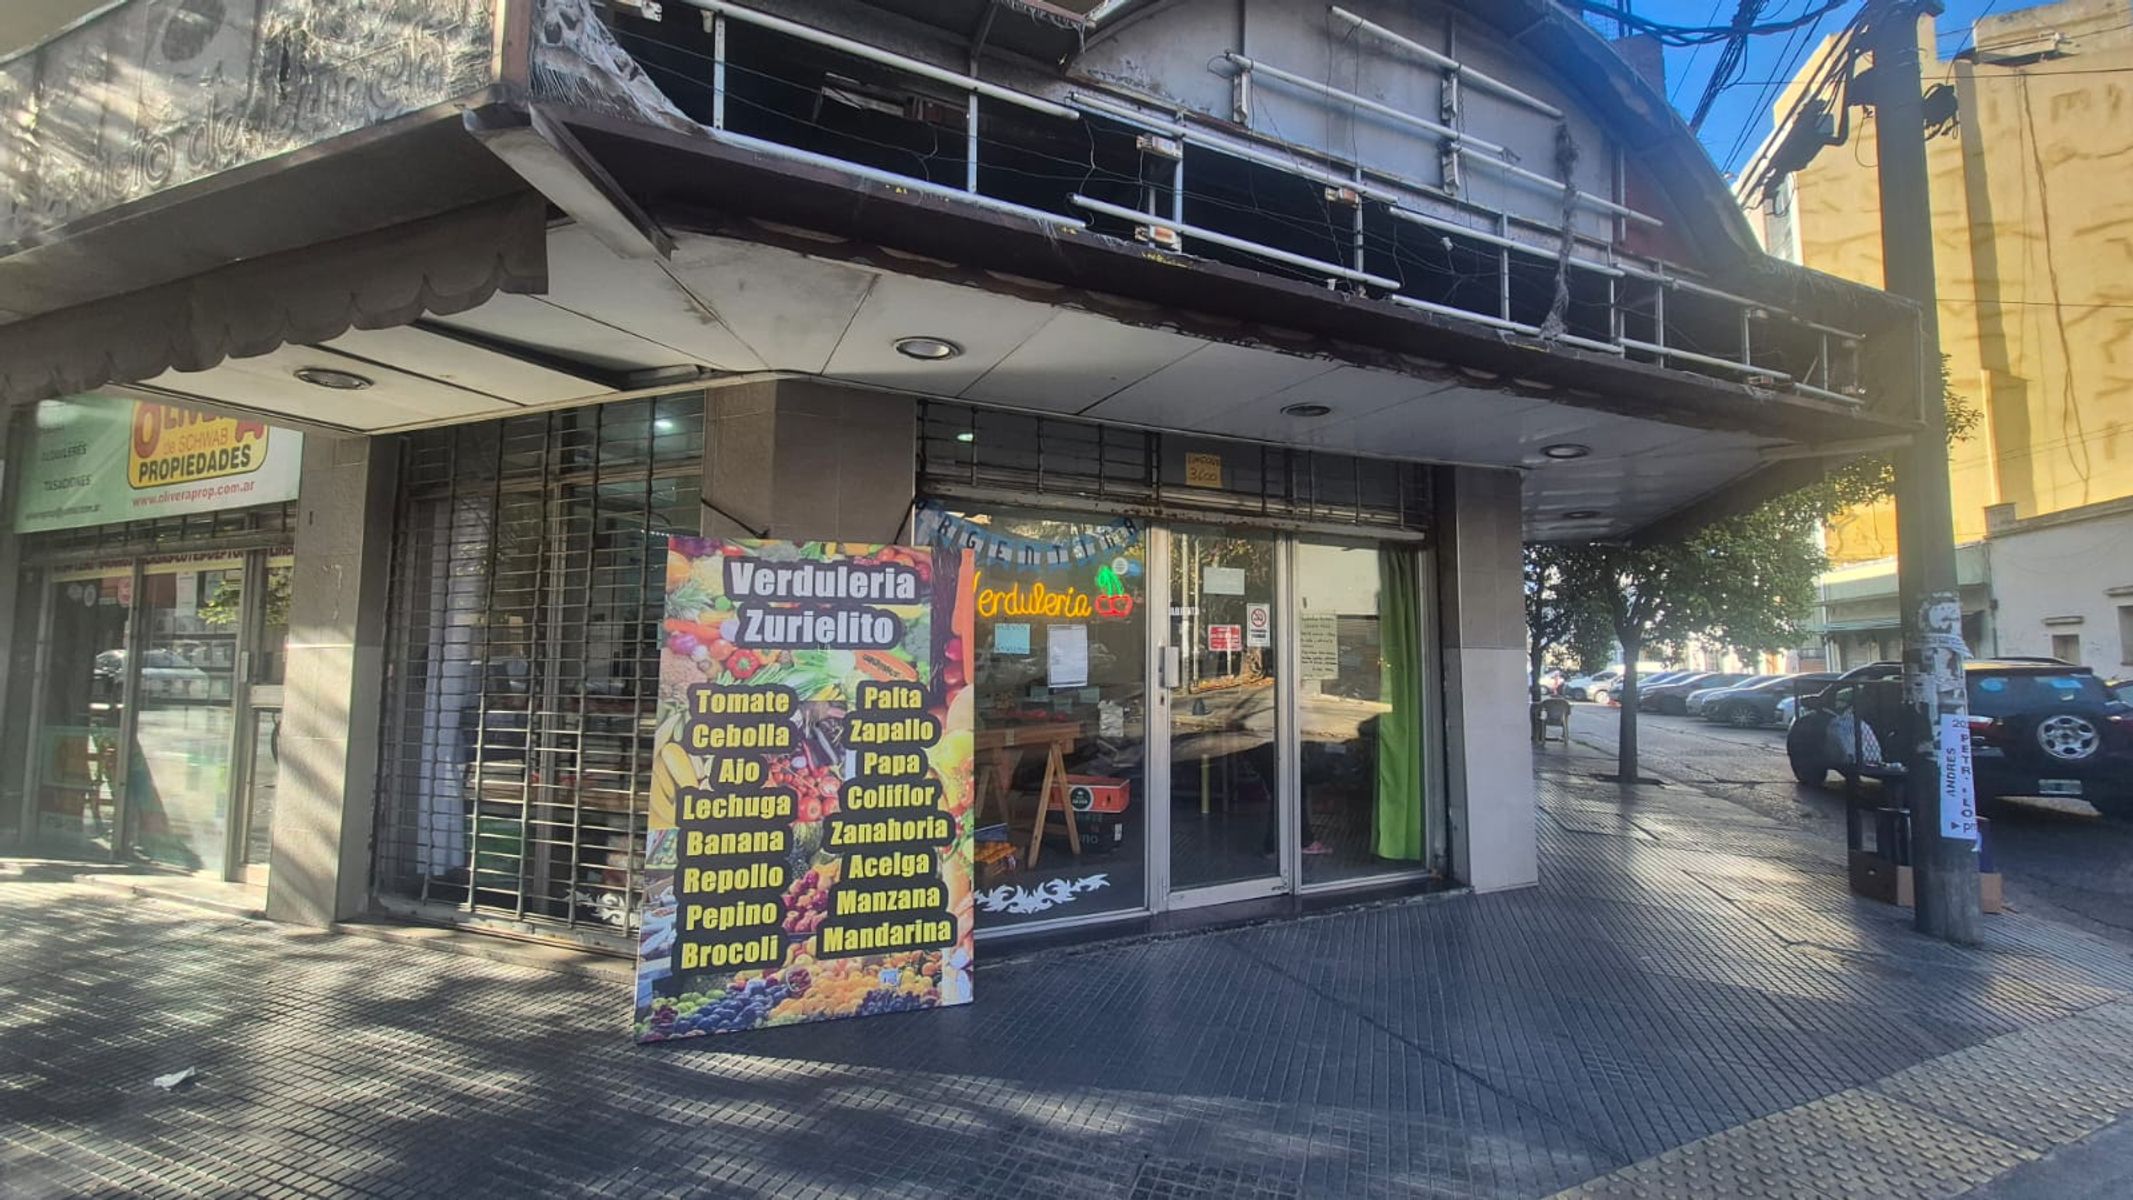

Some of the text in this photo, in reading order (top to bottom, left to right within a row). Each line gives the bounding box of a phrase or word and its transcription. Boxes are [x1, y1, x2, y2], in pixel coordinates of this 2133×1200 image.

[178, 427, 228, 452] SCHWAB
[138, 444, 252, 483] PROPIEDADES
[132, 480, 256, 509] www.oliveraprop.com.ar
[730, 560, 916, 600] Verduleria
[973, 571, 1092, 618] erduleria
[744, 608, 895, 644] Zurielito
[698, 690, 790, 713] Tomate
[865, 687, 922, 709] Palta
[693, 724, 790, 748] Cebolla
[851, 720, 934, 744] Zapallo
[719, 760, 760, 785] Ajo
[864, 753, 920, 775] Papa
[1946, 747, 1957, 797] ANDRES
[683, 795, 792, 820] Lechuga
[847, 786, 935, 810] Coliflor
[687, 831, 784, 856] Banana
[830, 817, 948, 845] Zanahoria
[683, 863, 784, 893] Repollo
[848, 853, 930, 880] Acelga
[837, 886, 941, 916] Manzana
[686, 903, 778, 931] Pepino
[823, 920, 952, 952] Mandarina
[681, 936, 778, 969] Brocoli
